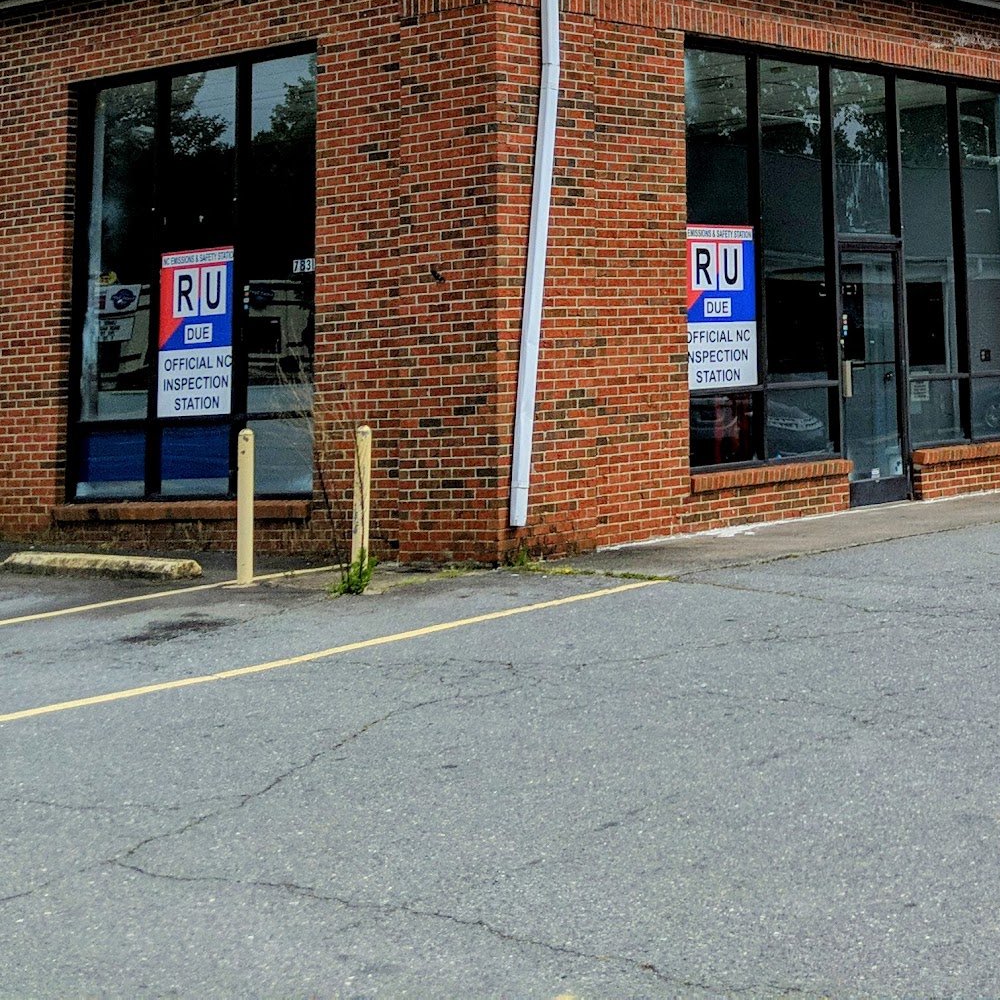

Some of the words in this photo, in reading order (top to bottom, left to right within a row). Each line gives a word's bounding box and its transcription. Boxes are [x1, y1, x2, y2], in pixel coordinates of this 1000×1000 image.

[687, 229, 711, 238] EMISSIONS
[716, 230, 733, 238] SAFETY
[734, 231, 751, 239] STATION
[164, 257, 170, 265] NC
[171, 255, 195, 265] EMISSIONS
[199, 252, 217, 262] SAFETY
[217, 250, 234, 260] STATIO
[696, 247, 712, 285] R
[723, 248, 738, 285] U
[178, 274, 193, 312] R
[206, 271, 221, 309] U
[706, 301, 729, 314] DUE
[187, 326, 210, 341] DUE
[687, 330, 733, 344] OFFICIAL
[736, 329, 751, 342] NC
[164, 356, 213, 372] OFFICIAL
[216, 354, 233, 368] NC
[687, 348, 749, 364] NSPECTION
[163, 375, 229, 391] INSPECTION
[696, 368, 741, 384] STATION
[174, 395, 220, 411] STATION
